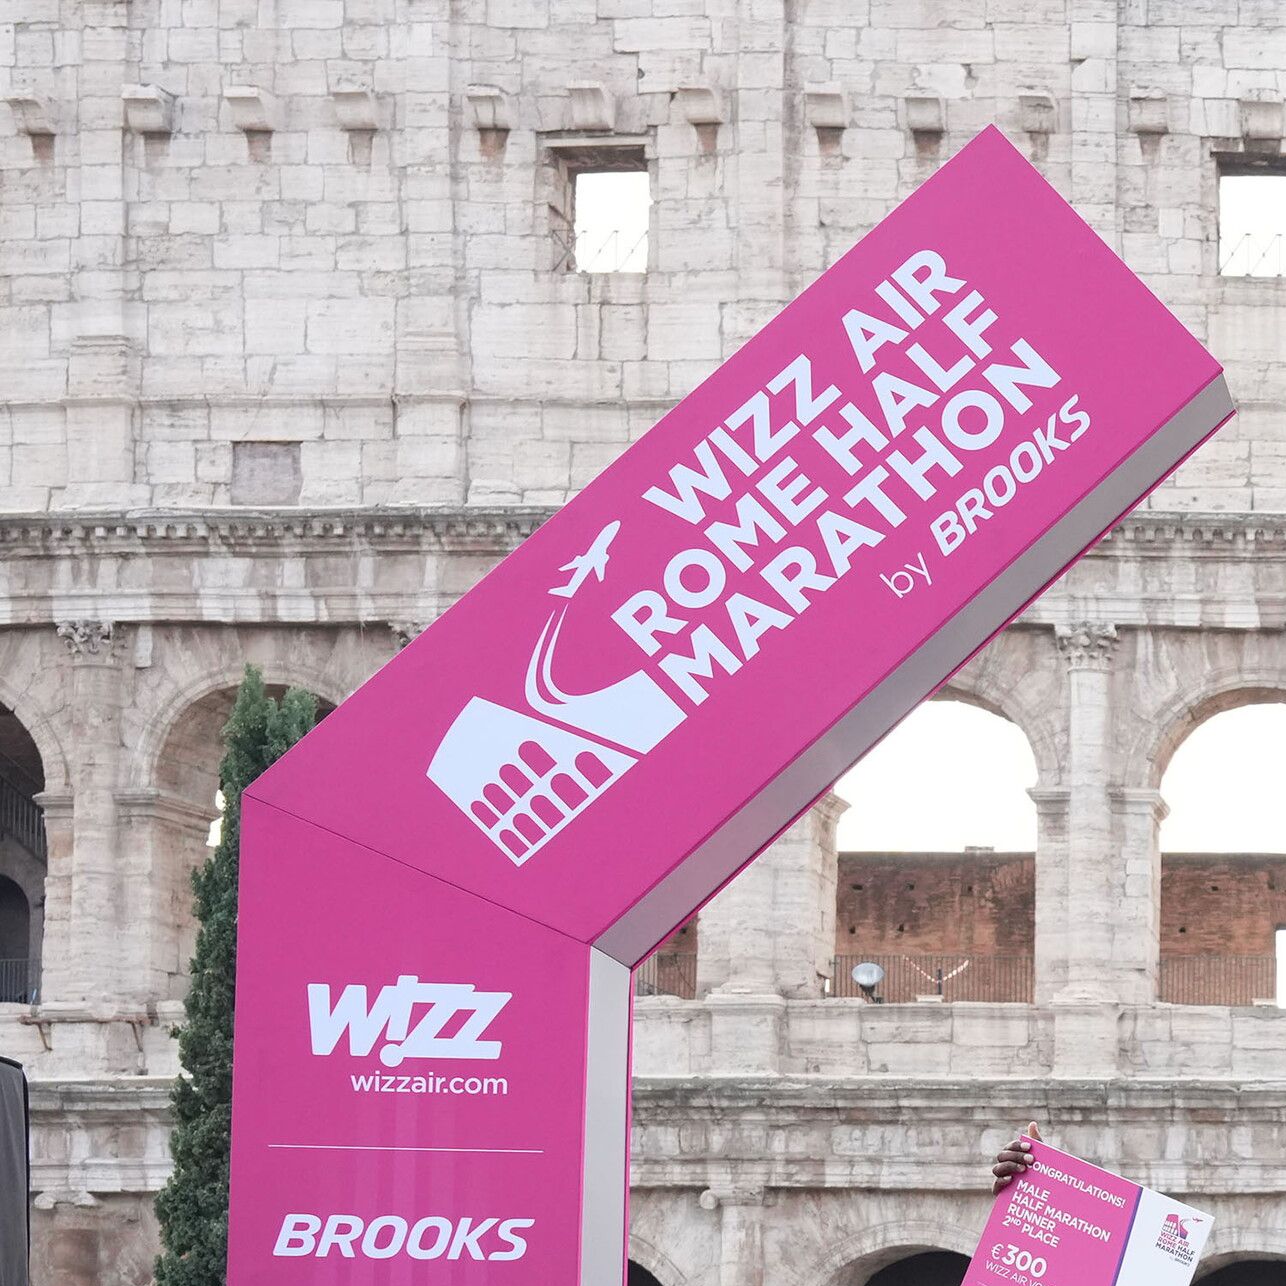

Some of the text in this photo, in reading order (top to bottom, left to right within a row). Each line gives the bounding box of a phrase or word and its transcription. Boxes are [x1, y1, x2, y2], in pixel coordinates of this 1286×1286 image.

[642, 249, 967, 526] WIZZ AIR
[610, 289, 999, 659] ROME HALF
[879, 394, 1091, 598] by BROOKS
[657, 339, 1062, 705] MARATHON
[350, 1072, 508, 1095] wizzair.com
[1017, 1180, 1050, 1202] MALE
[273, 1214, 535, 1261] BROOKS
[1008, 1203, 1056, 1232] RUNNER
[1012, 1192, 1111, 1242] HALF MARATHON
[1021, 1224, 1060, 1248] PLACE
[985, 1260, 1010, 1278] WIZZ
[1010, 1273, 1027, 1286] AIR
